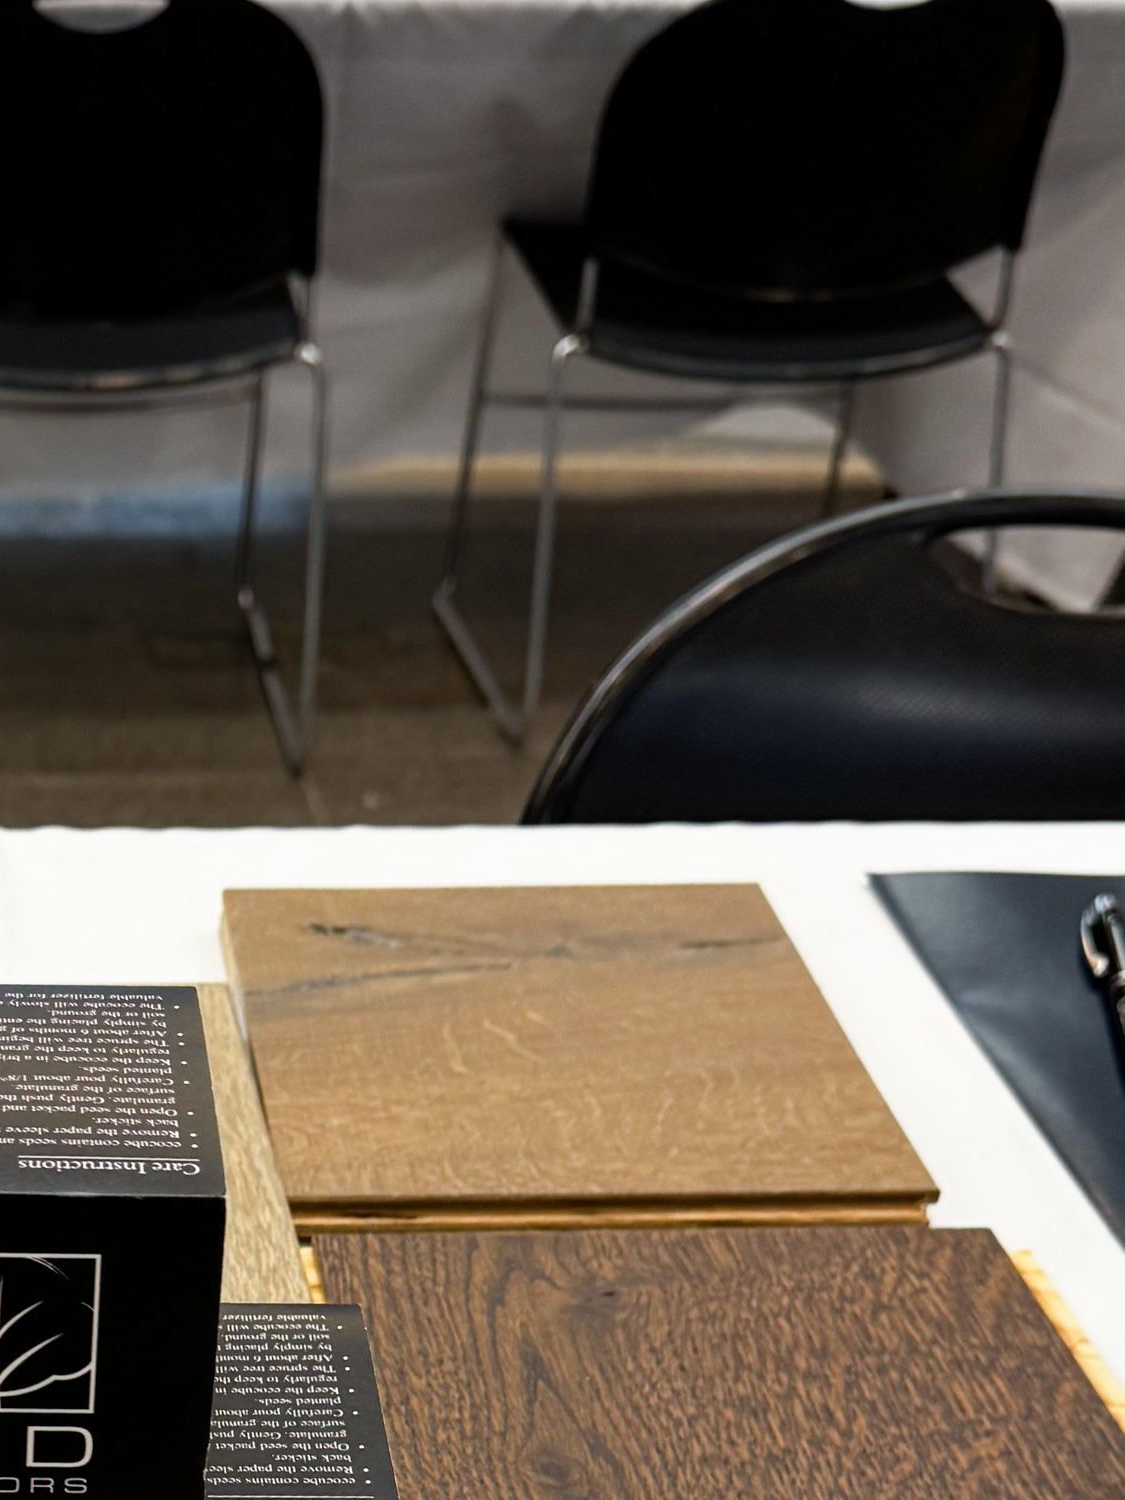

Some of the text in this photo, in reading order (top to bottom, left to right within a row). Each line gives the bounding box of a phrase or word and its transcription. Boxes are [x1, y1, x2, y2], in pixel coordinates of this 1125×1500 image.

[33, 1074, 71, 1082] about
[74, 1073, 105, 1081] pour
[111, 1074, 174, 1085] Carefully
[82, 1086, 103, 1094] the
[106, 1086, 122, 1094] of
[125, 1087, 175, 1095] surface
[21, 1092, 53, 1102] push
[59, 1093, 105, 1103] Gently
[1, 1104, 27, 1112] and
[31, 1103, 76, 1113] packet
[79, 1106, 111, 1114] seed
[114, 1107, 136, 1115] the
[139, 1105, 178, 1115] Open
[146, 1119, 178, 1127] back
[5, 1126, 49, 1135] sleeve
[52, 1125, 92, 1133] paper
[96, 1128, 118, 1136] the
[121, 1129, 179, 1138] Remove
[18, 1138, 56, 1146] seeds
[60, 1139, 120, 1147] contains
[123, 1140, 182, 1149] ecocube
[18, 1159, 200, 1174] Care Instructions
[252, 1355, 333, 1363] After about 6
[215, 1366, 238, 1374] will
[268, 1363, 308, 1371] spruce
[311, 1365, 336, 1373] The
[233, 1374, 263, 1384] keep
[282, 1374, 338, 1384] regularly
[230, 1387, 281, 1396] ecocube
[284, 1387, 303, 1395] the
[305, 1385, 339, 1395] Keep
[295, 1396, 341, 1406] planted
[214, 1407, 344, 1418] Carefully pour about
[260, 1420, 345, 1429] surface of the
[238, 1429, 281, 1440] Gently
[215, 1441, 350, 1451] Open the seed packet
[321, 1454, 351, 1463] back
[236, 1463, 353, 1474] Remove the paper
[206, 1477, 356, 1486] ecocube contains seeds
